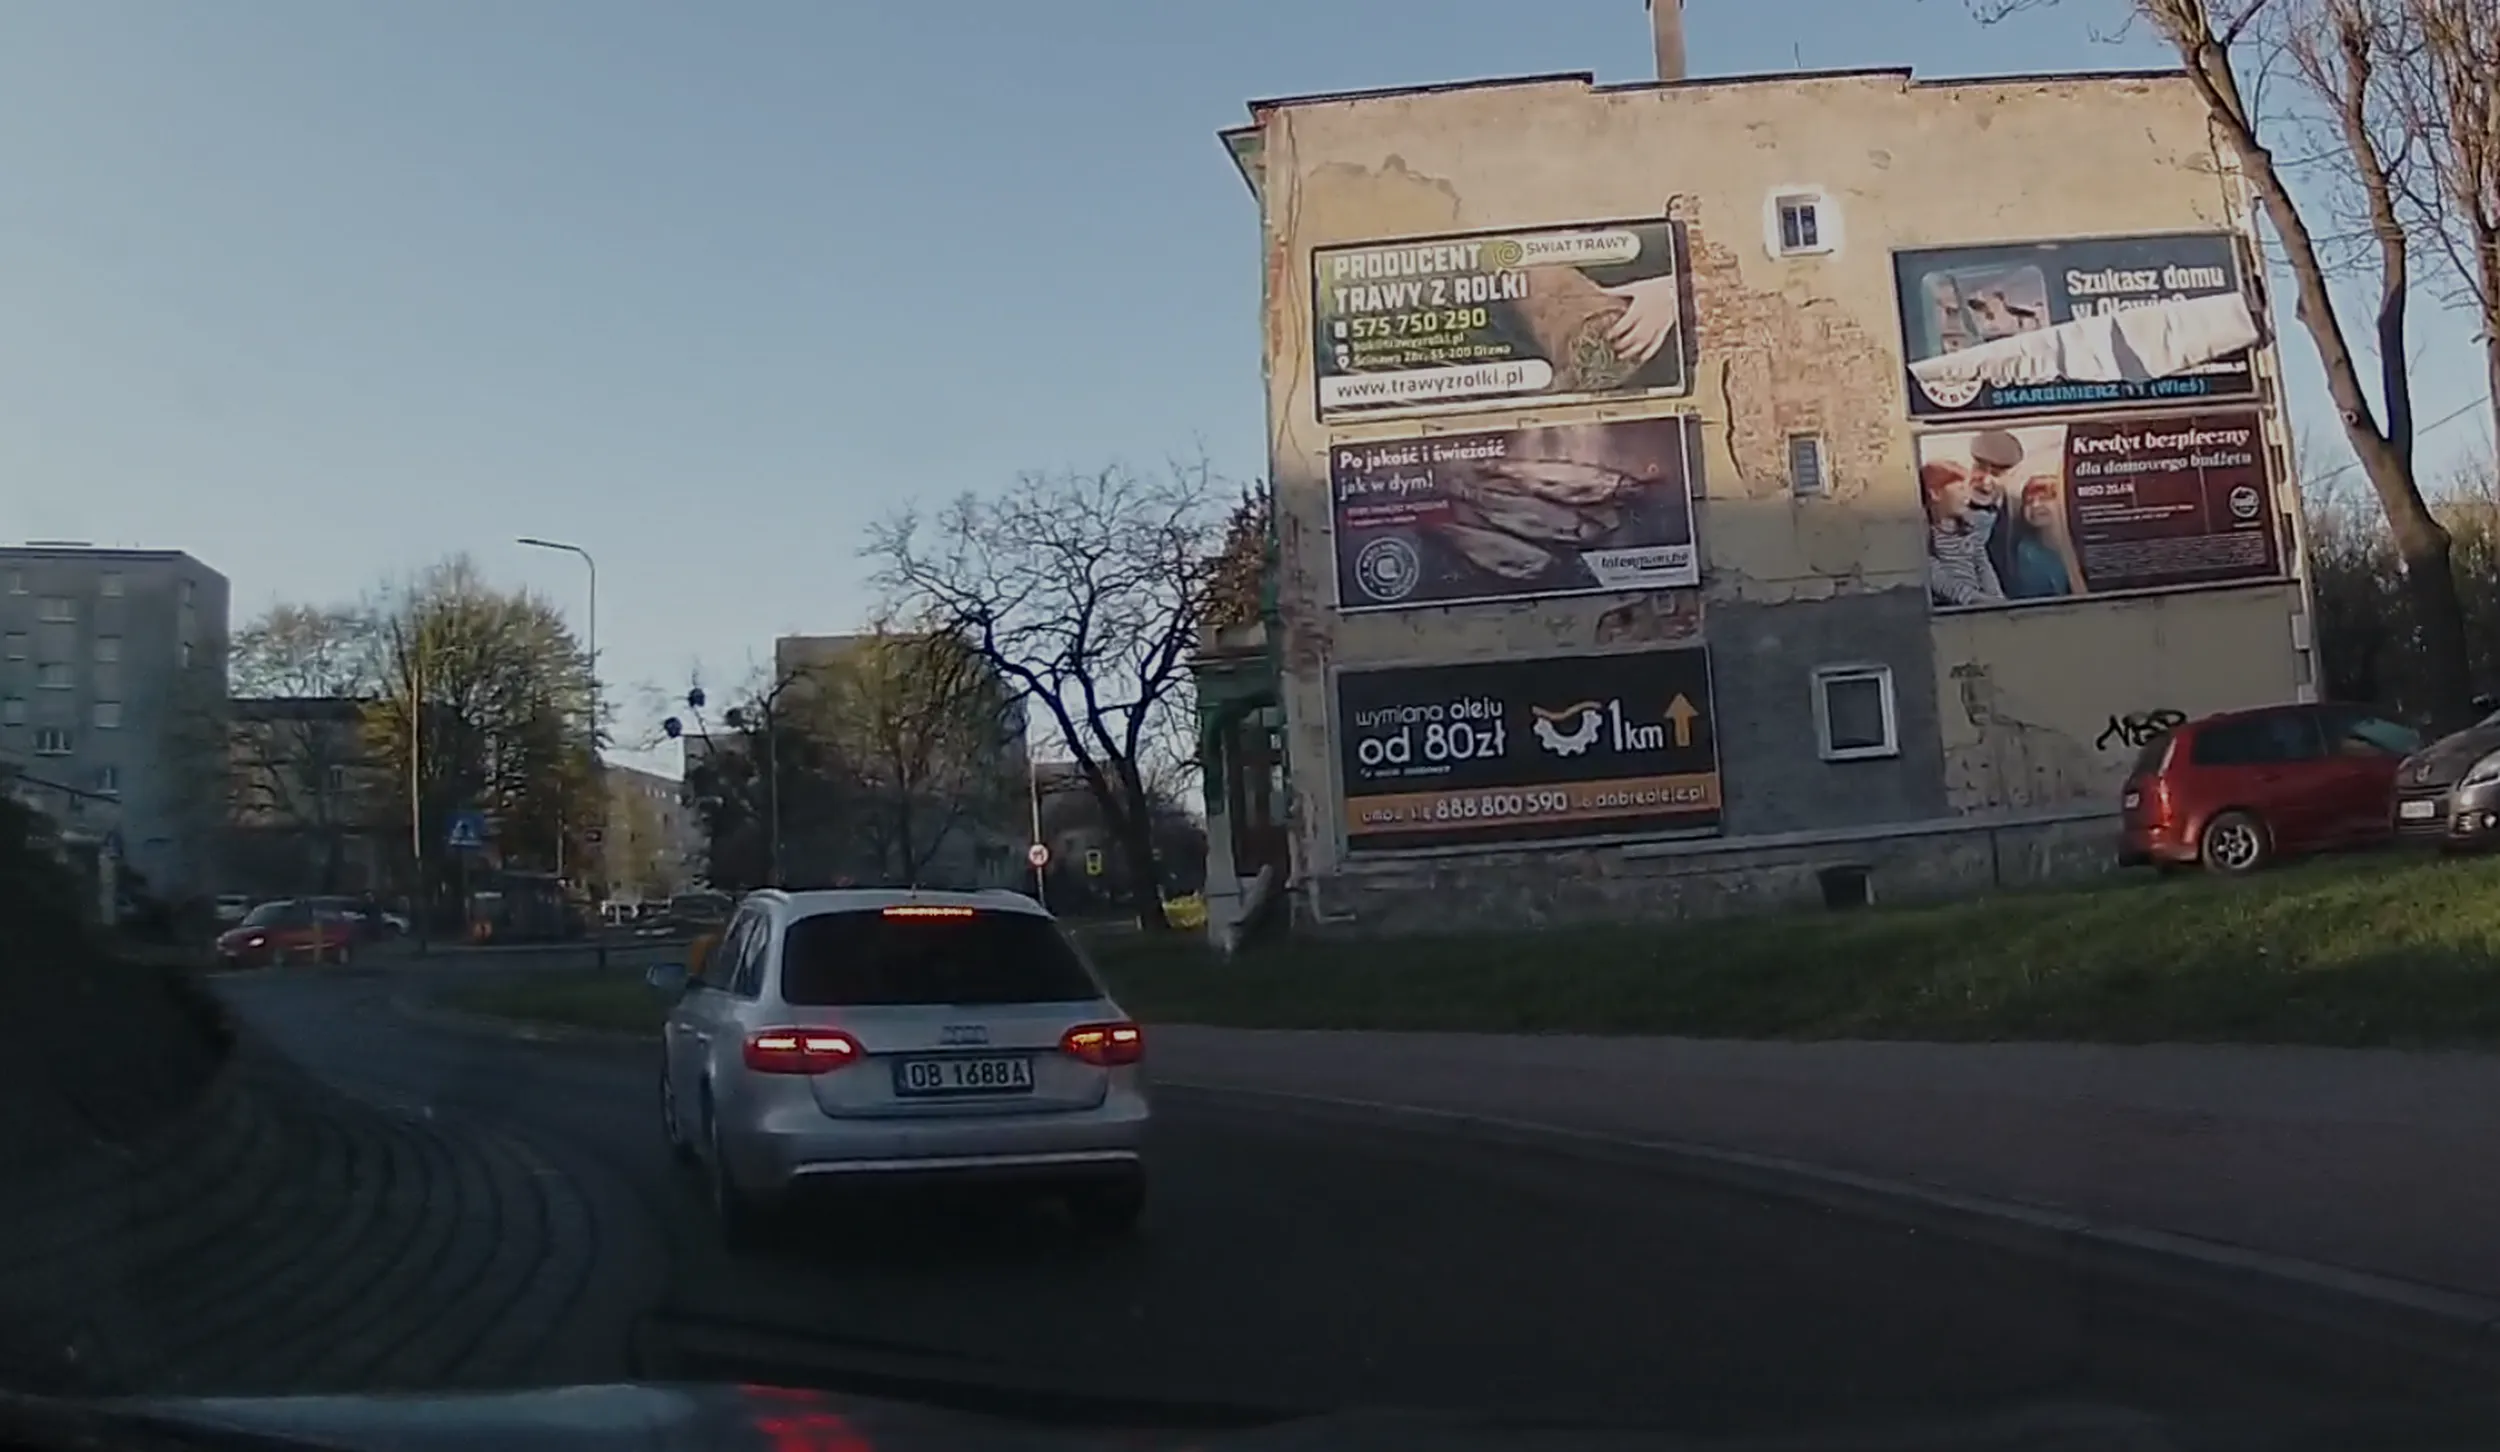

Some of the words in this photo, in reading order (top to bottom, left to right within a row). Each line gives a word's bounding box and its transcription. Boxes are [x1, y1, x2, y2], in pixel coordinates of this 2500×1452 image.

[1577, 235, 1629, 251] TRAWY
[1334, 243, 1482, 281] PRODUCENT
[1334, 281, 1422, 315] TRAWY
[1430, 279, 1447, 306] Z
[1455, 271, 1528, 304] ROLKI
[2066, 268, 2160, 296] Szukasz
[2163, 264, 2226, 290] domu
[1353, 315, 1391, 338] 575
[1398, 311, 1438, 334] 750
[1444, 308, 1487, 330] 290
[1337, 365, 1524, 398] www.trawyzrolki.pl
[1340, 451, 1363, 469] Po
[1364, 446, 1419, 474] jakość
[1422, 446, 1430, 462] i
[1433, 439, 1506, 462] świeżość
[2073, 434, 2141, 455] Kredyt
[2145, 428, 2250, 450] bezpieczny
[2075, 461, 2101, 477] dla
[2103, 456, 2188, 474] domowego
[2190, 453, 2252, 468] budżetu
[1339, 477, 1367, 501] jak
[1371, 481, 1385, 493] w
[1389, 469, 1434, 496] dym!
[1356, 706, 1443, 727] wymiana
[1450, 697, 1503, 720] oleju
[1608, 698, 1623, 752] 1
[1624, 721, 1663, 750] km
[1358, 726, 1410, 766] od
[1424, 719, 1505, 761] 80zł
[1436, 799, 1477, 819] 888
[1481, 795, 1521, 816] 800
[1526, 791, 1567, 813] 590
[911, 1063, 943, 1087] OB
[954, 1062, 1026, 1085] 1688A
